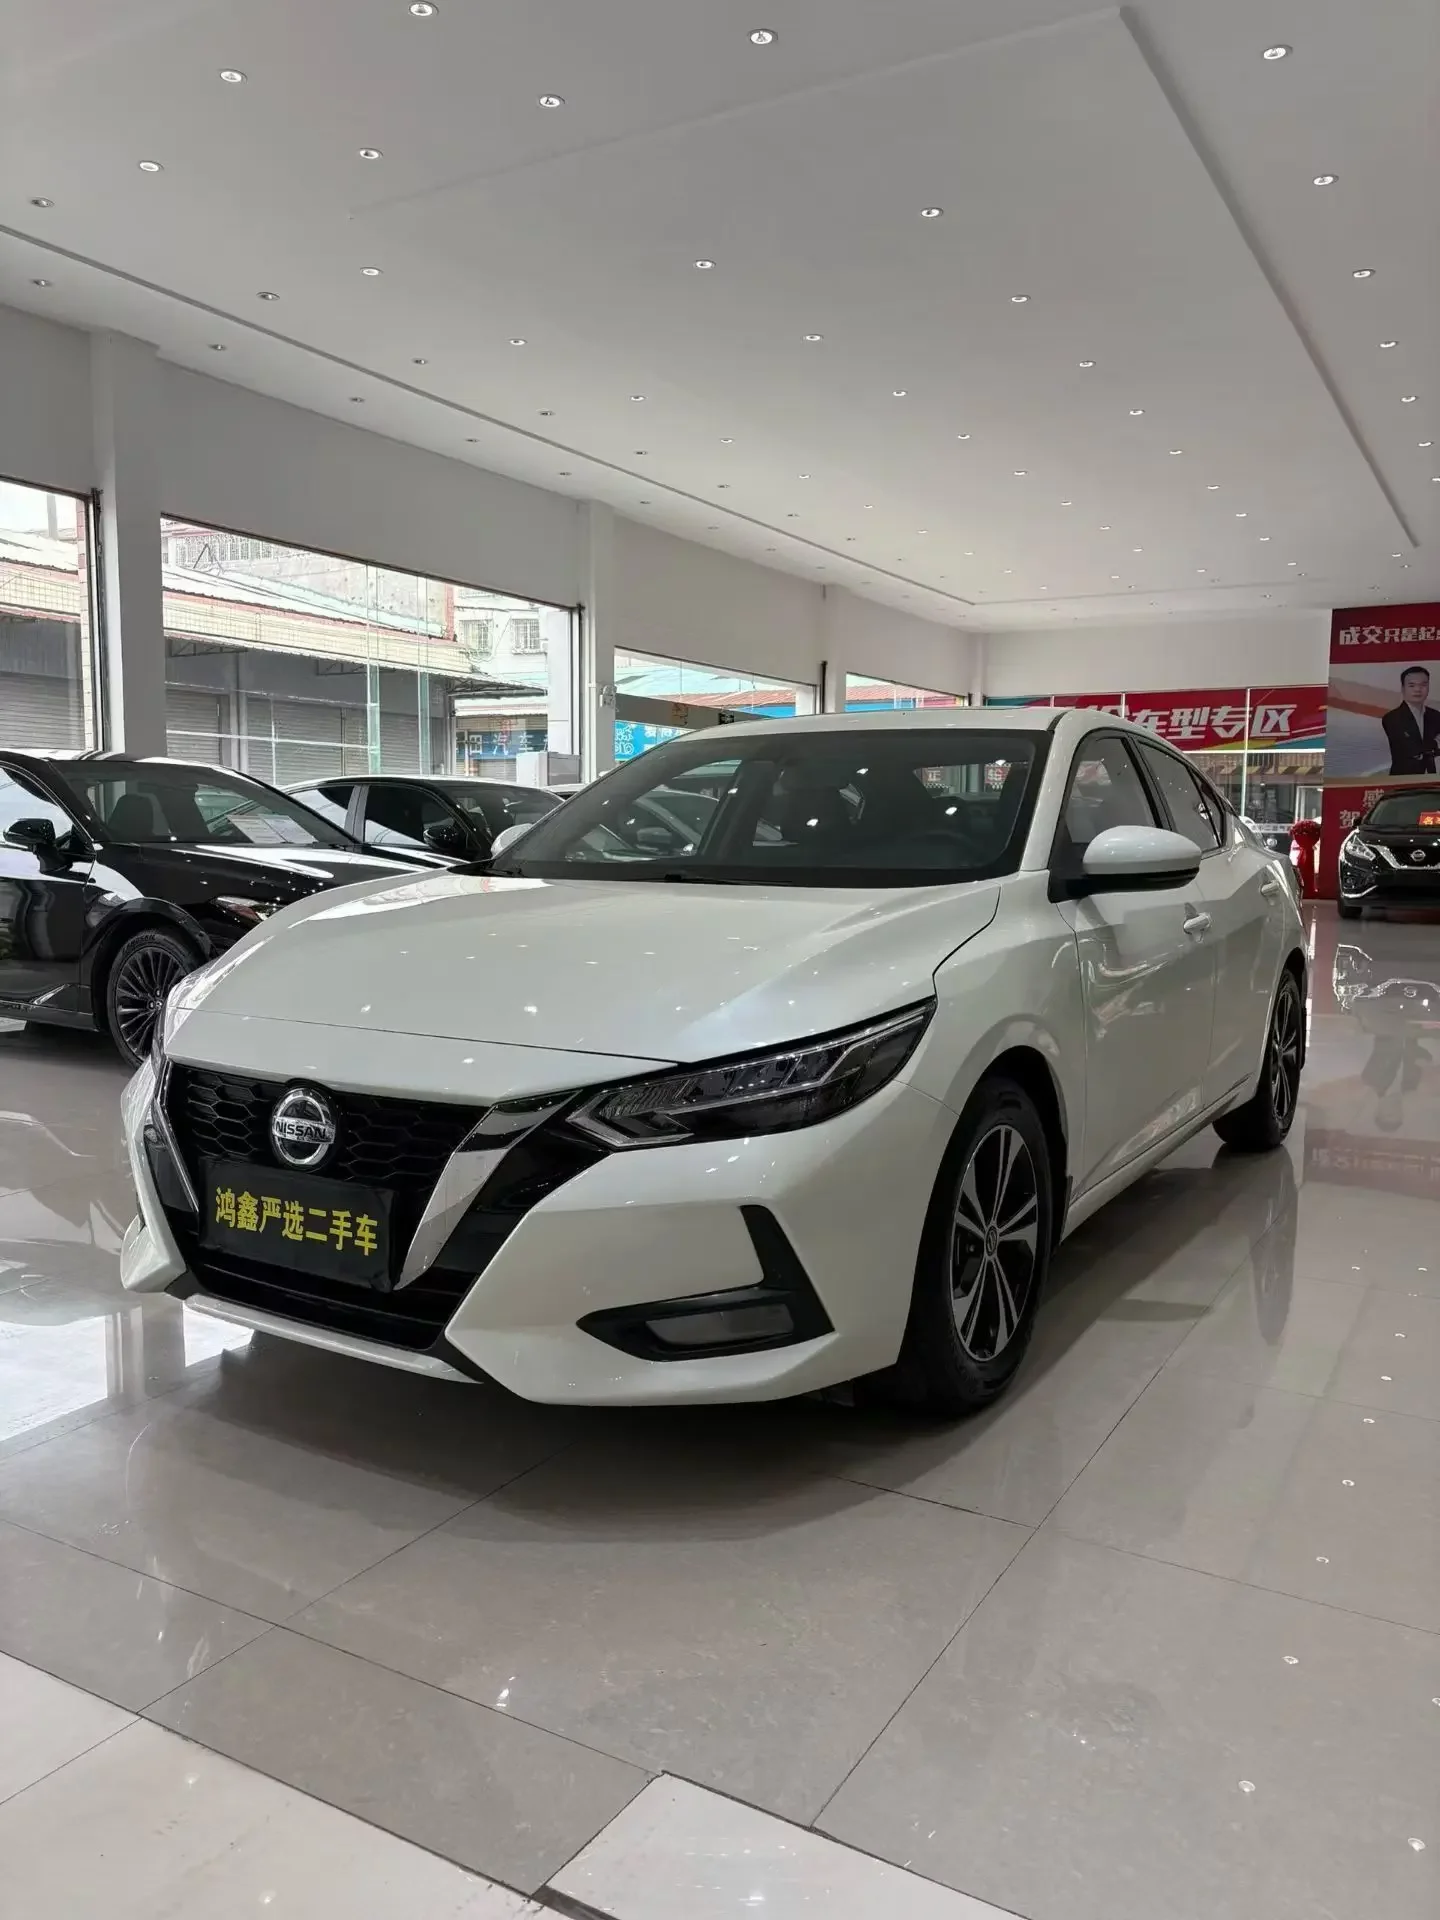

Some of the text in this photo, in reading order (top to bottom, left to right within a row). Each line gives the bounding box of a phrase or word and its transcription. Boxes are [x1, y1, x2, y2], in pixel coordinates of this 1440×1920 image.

[1339, 624, 1440, 646] 成交只是起
[275, 1120, 327, 1138] NISSAN
[215, 1187, 378, 1256] 鸿鑫严选二手车
